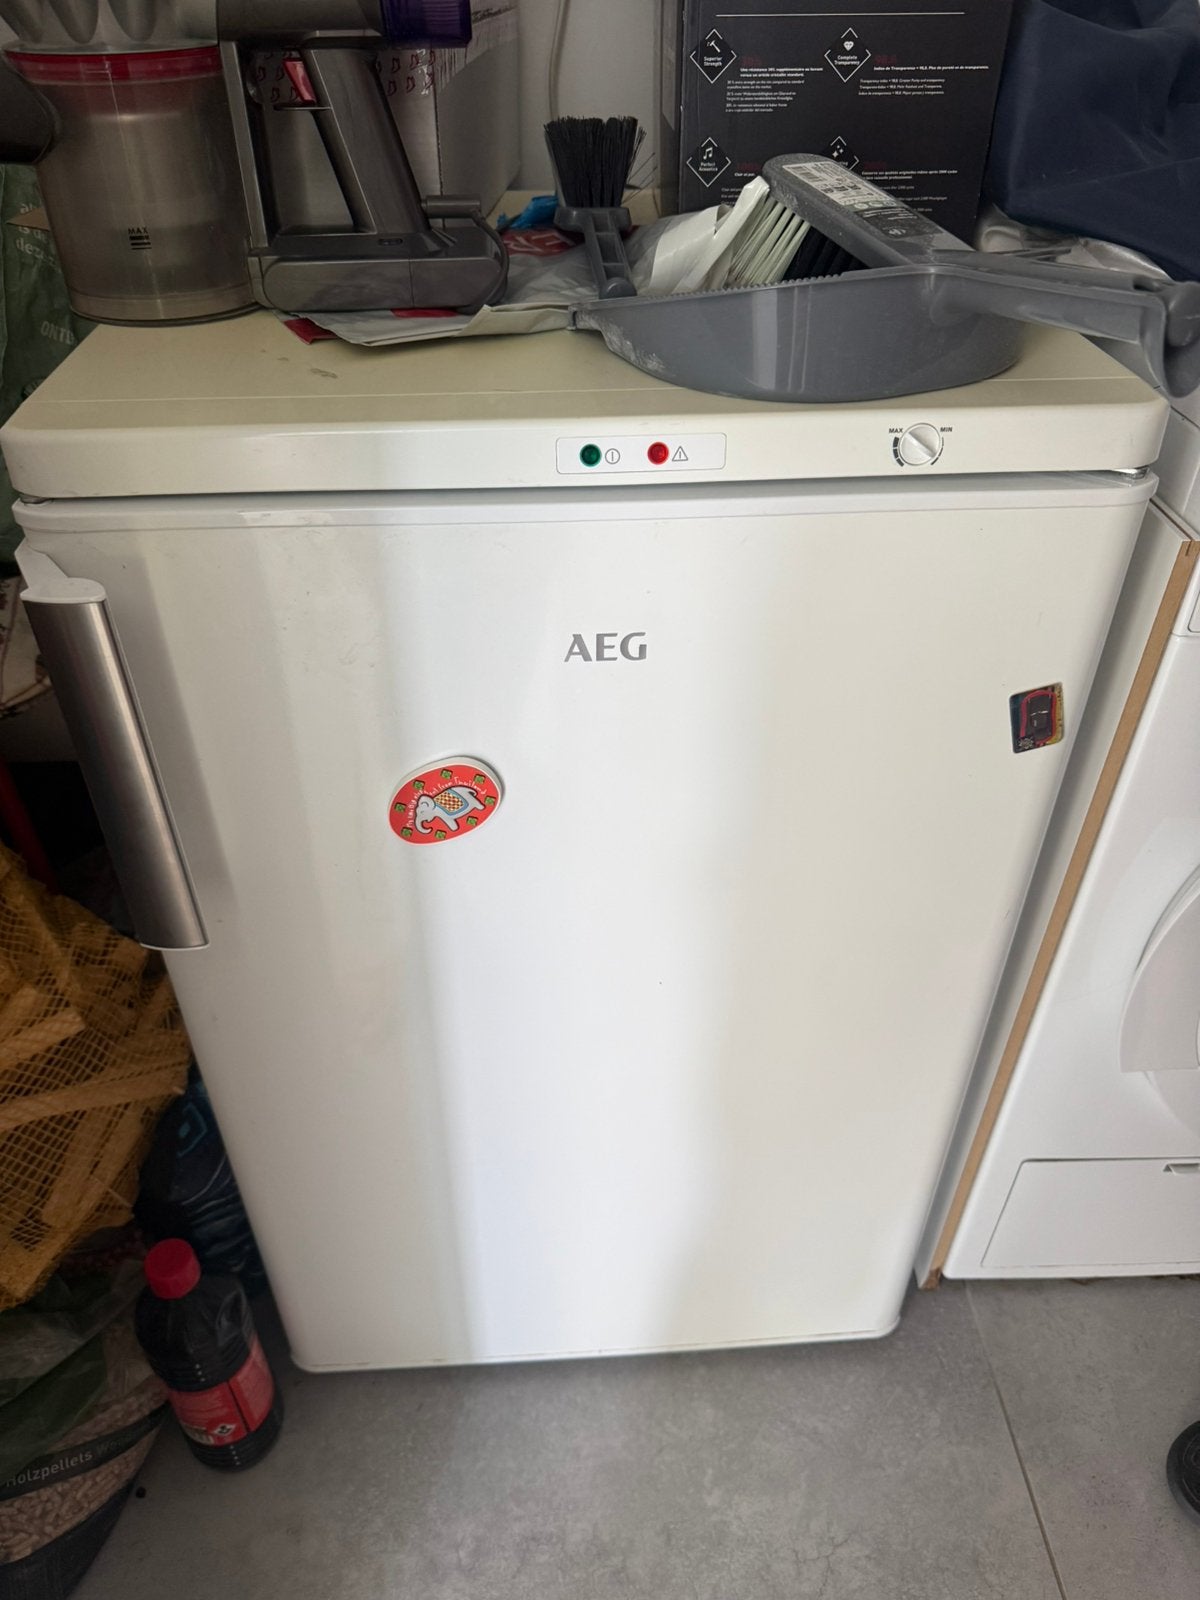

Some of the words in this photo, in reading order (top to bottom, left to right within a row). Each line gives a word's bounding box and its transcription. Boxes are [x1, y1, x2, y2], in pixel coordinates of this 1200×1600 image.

[128, 226, 149, 235] MAX
[564, 632, 647, 662] AEG
[453, 776, 487, 795] Thailand
